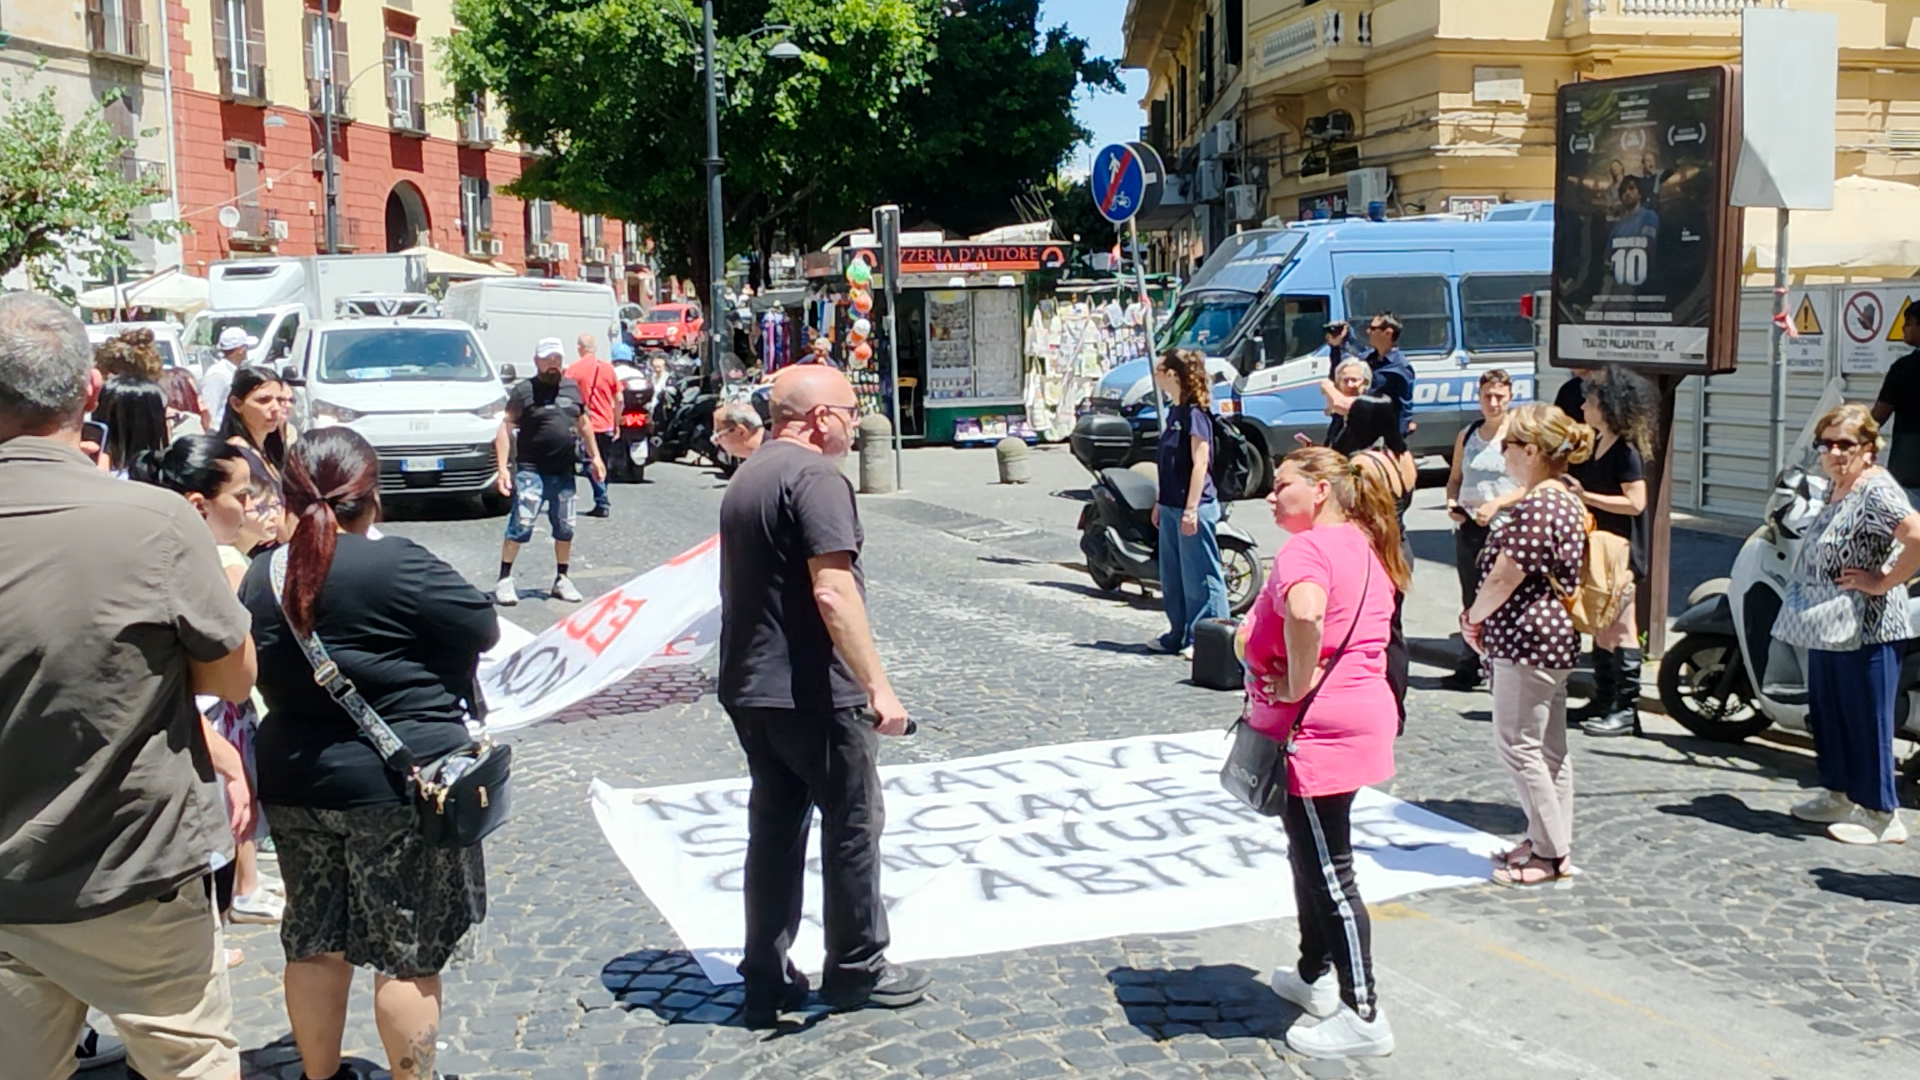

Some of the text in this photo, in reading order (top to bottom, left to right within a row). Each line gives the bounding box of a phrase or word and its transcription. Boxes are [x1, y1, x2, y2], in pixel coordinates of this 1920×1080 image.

[899, 247, 1039, 263] ZZERIA D'AUTORE
[1611, 248, 1648, 285] 10
[1413, 379, 1532, 404] OLIA
